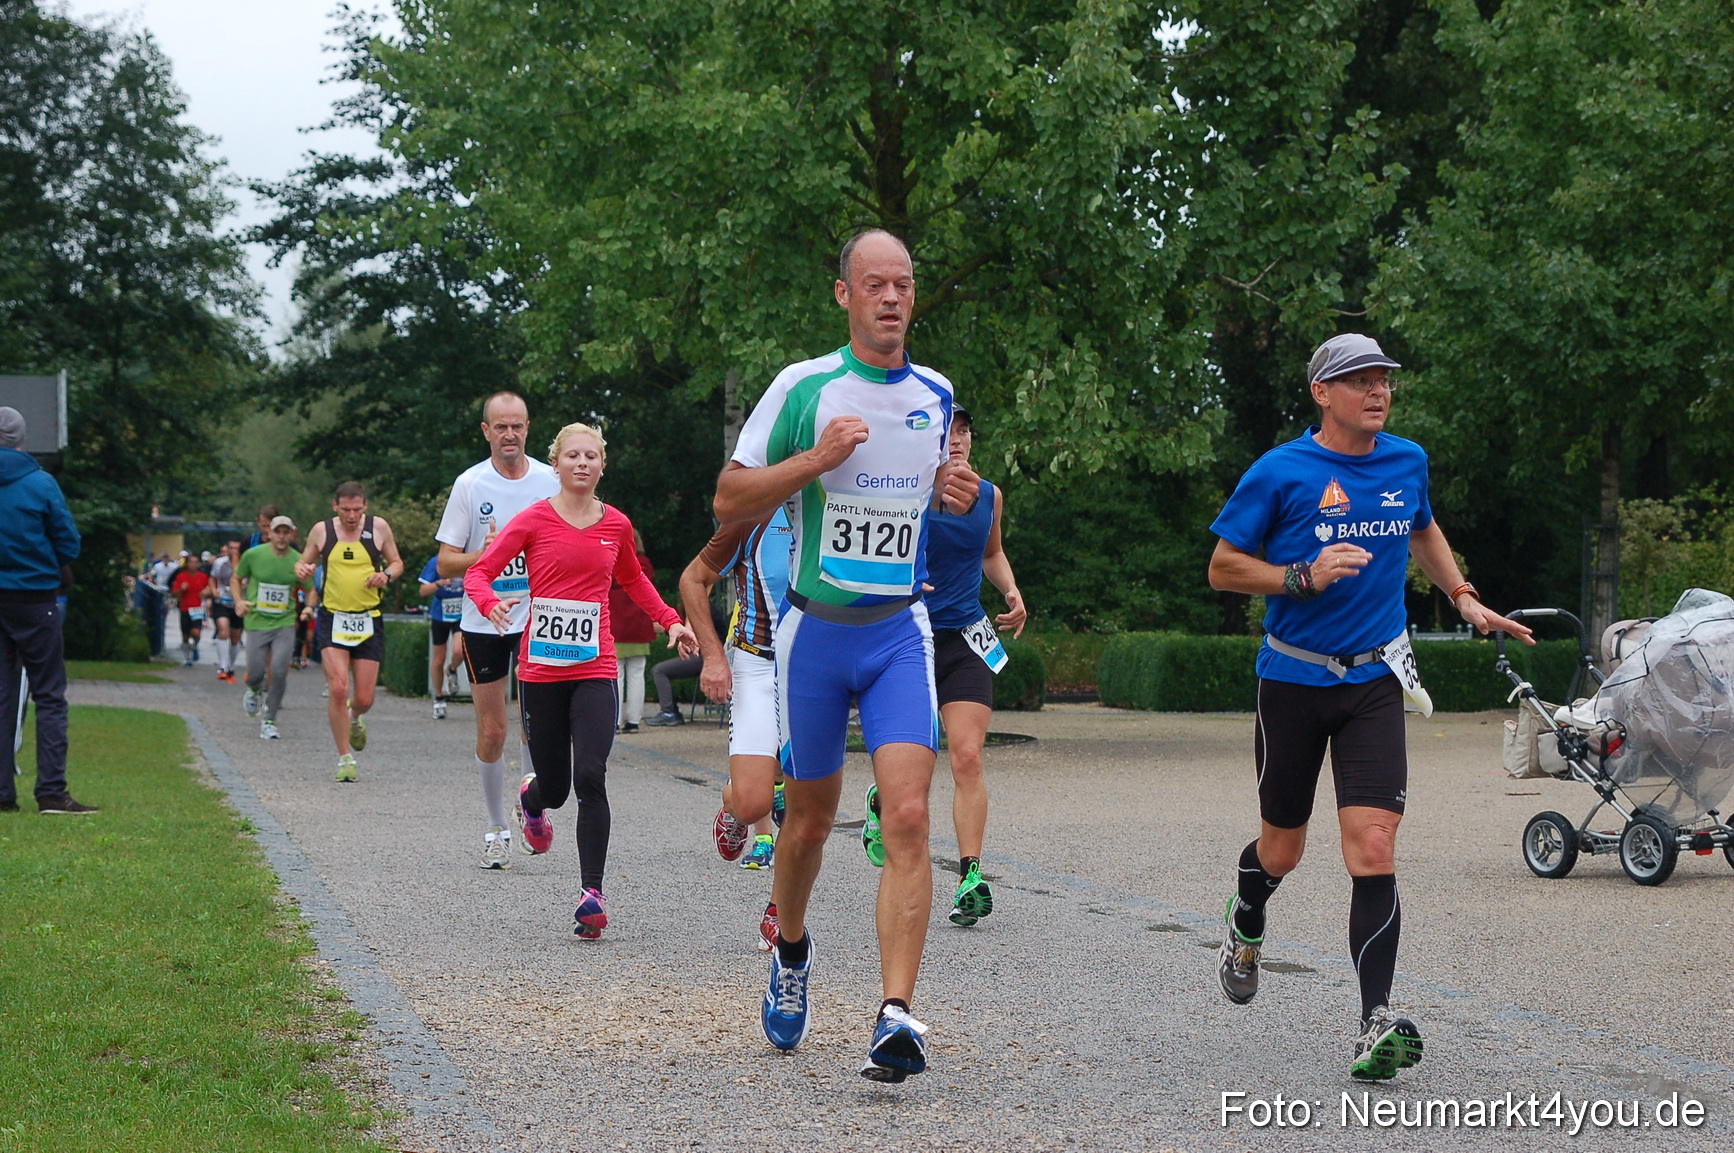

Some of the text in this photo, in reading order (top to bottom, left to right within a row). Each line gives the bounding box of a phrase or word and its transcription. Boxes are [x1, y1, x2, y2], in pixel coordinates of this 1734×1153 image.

[856, 473, 919, 488] Gerhard
[826, 503, 908, 519] PARTL Neumarkt
[1337, 520, 1411, 539] BARCLAYS
[832, 518, 913, 558] 3120
[502, 581, 528, 590] Martin
[265, 591, 285, 602] 162
[532, 603, 589, 615] PARTL Neumarkt
[342, 620, 365, 632] 438
[536, 614, 593, 643] 2649
[544, 645, 580, 658] Sabrina
[1385, 648, 1403, 664] PARTL
